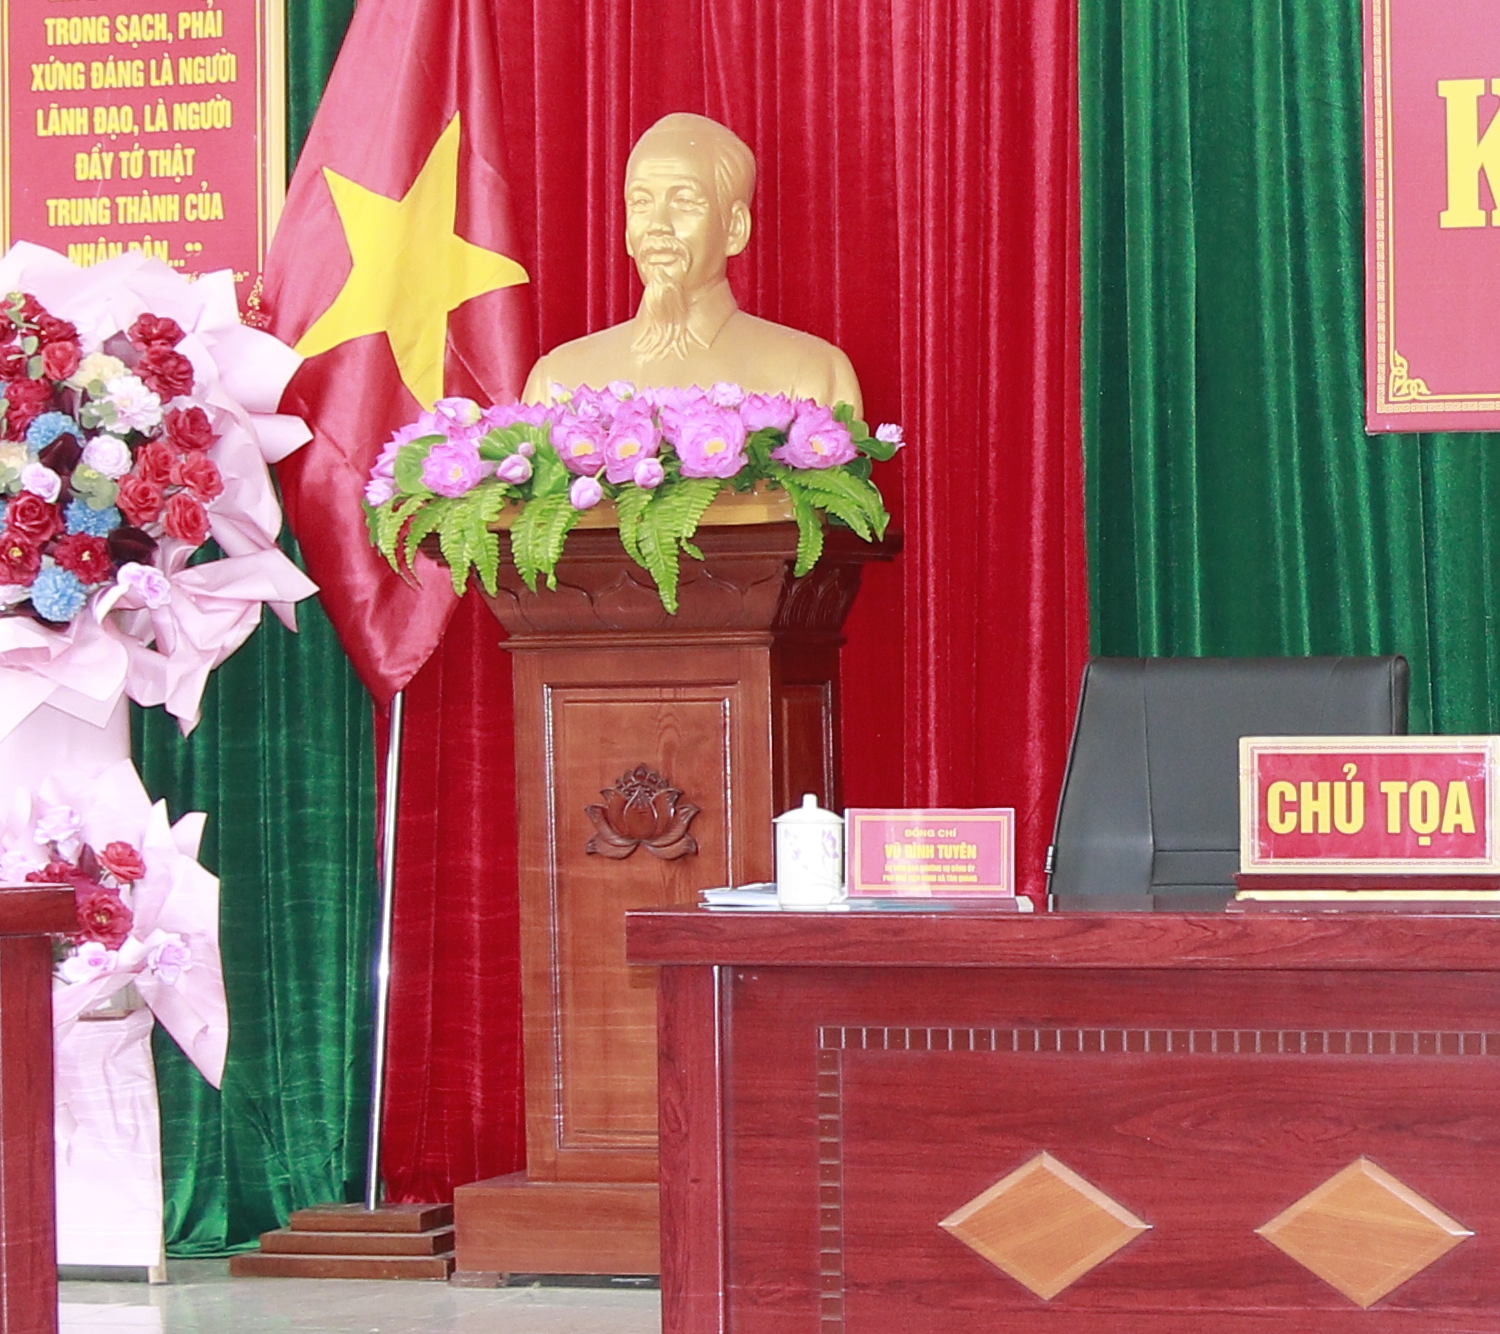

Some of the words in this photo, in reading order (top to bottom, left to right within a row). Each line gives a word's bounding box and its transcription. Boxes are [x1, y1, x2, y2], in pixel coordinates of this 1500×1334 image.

[44, 16, 112, 45] TRONG
[115, 13, 174, 47] SẠCH,
[178, 0, 224, 39] PHẢI
[31, 56, 87, 91] XỨNG
[90, 56, 146, 89] ĐÁNG
[149, 54, 175, 86] LÀ
[178, 49, 238, 84] NGƯỜI
[36, 104, 91, 136] LÃNH
[92, 105, 140, 139] ĐẠO,
[143, 99, 170, 132] LÀ
[172, 95, 233, 130] NGƯỜI
[75, 144, 116, 181] ĐẦY
[118, 144, 146, 178] TỚ
[148, 144, 197, 182] THẬT
[46, 197, 112, 226] TRUNG
[115, 191, 182, 223] THÀNH
[184, 182, 224, 221] CỦA
[1267, 763, 1365, 833] CHỦ
[1381, 781, 1476, 845] TỌA
